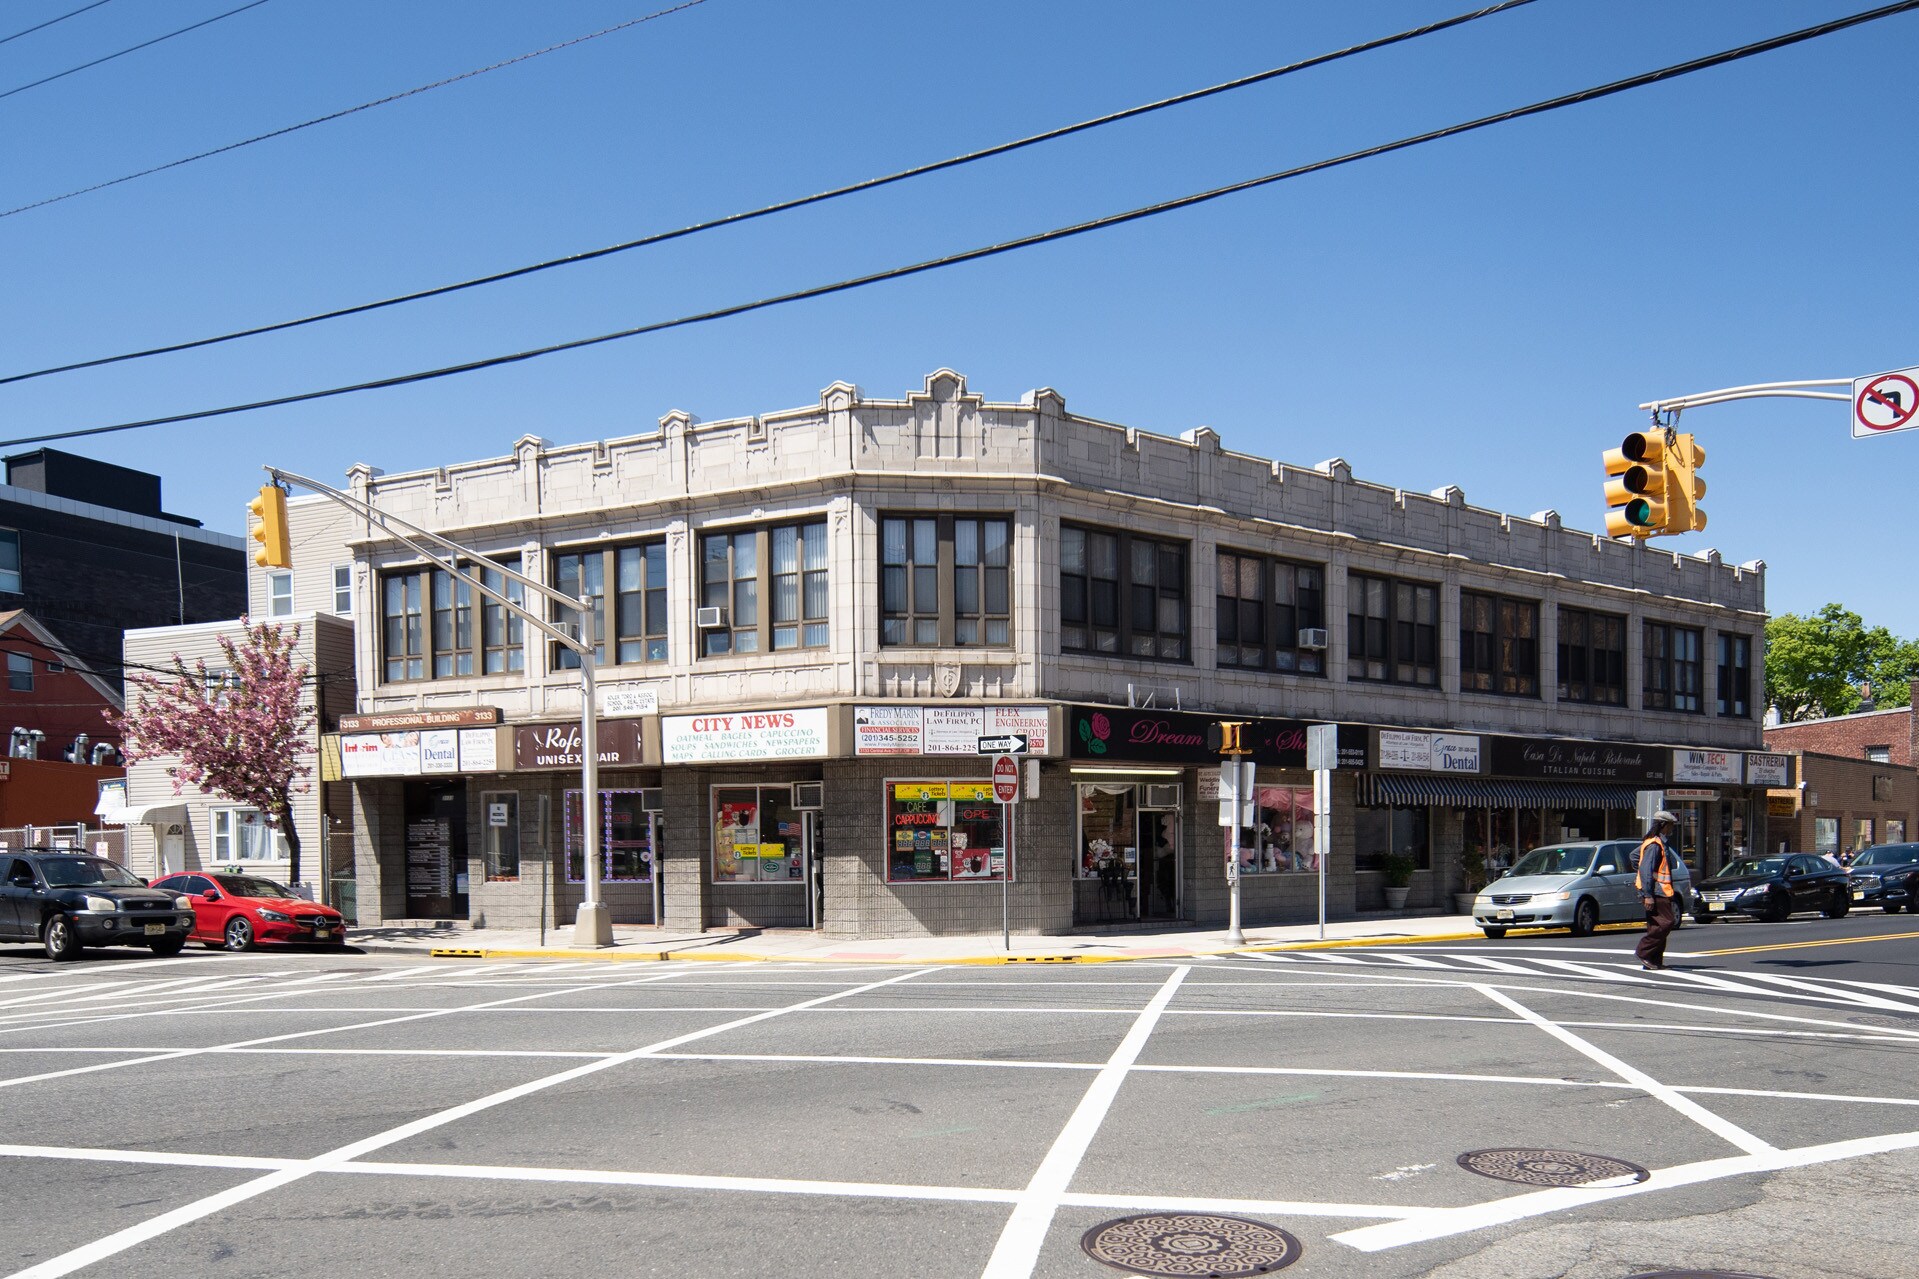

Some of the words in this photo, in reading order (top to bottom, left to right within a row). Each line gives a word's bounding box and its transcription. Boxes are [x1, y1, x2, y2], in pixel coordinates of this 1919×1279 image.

[870, 707, 893, 719] FREDY
[893, 707, 919, 719] MARIN
[995, 708, 1020, 718] FLEX
[342, 719, 360, 729] 3133
[371, 715, 424, 728] PROFESSIONAL
[426, 713, 460, 724] BUILDING
[474, 711, 493, 721] 3133
[691, 717, 733, 733] CITY
[741, 713, 795, 730] NEWS
[926, 717, 943, 725] LAW
[970, 717, 983, 725] PC
[995, 718, 1048, 728] ENGINEERING
[676, 734, 713, 742] OATMEAL
[721, 732, 752, 740] BAGELS
[760, 729, 814, 738] CAPUCCINO
[1128, 719, 1204, 745] Dream
[670, 743, 697, 751] SOUPS
[704, 740, 758, 749] SANDWICHES
[766, 737, 820, 747] NEWSPAPERS
[928, 744, 977, 752] 201-864-225
[982, 741, 996, 749] ONE
[997, 740, 1012, 748] WAY
[424, 747, 455, 760] Dental
[671, 752, 694, 760] MAPS
[701, 749, 737, 759] CALLING
[739, 749, 767, 758] CARDS
[775, 746, 816, 756] GROCERY
[1522, 744, 1545, 760] Casa
[536, 754, 583, 765] UNISEX
[1443, 753, 1478, 770] Dental
[1689, 752, 1705, 764] WIN
[1707, 753, 1726, 765] TECH
[1749, 755, 1785, 768] SASTRERIA
[997, 764, 1004, 772] DO
[1004, 764, 1014, 772] NOT
[1543, 765, 1579, 775] ITALIAN
[1582, 767, 1616, 776] CUISINE
[998, 785, 1014, 794] ENTER
[895, 813, 941, 825] CAPPUCCINO
